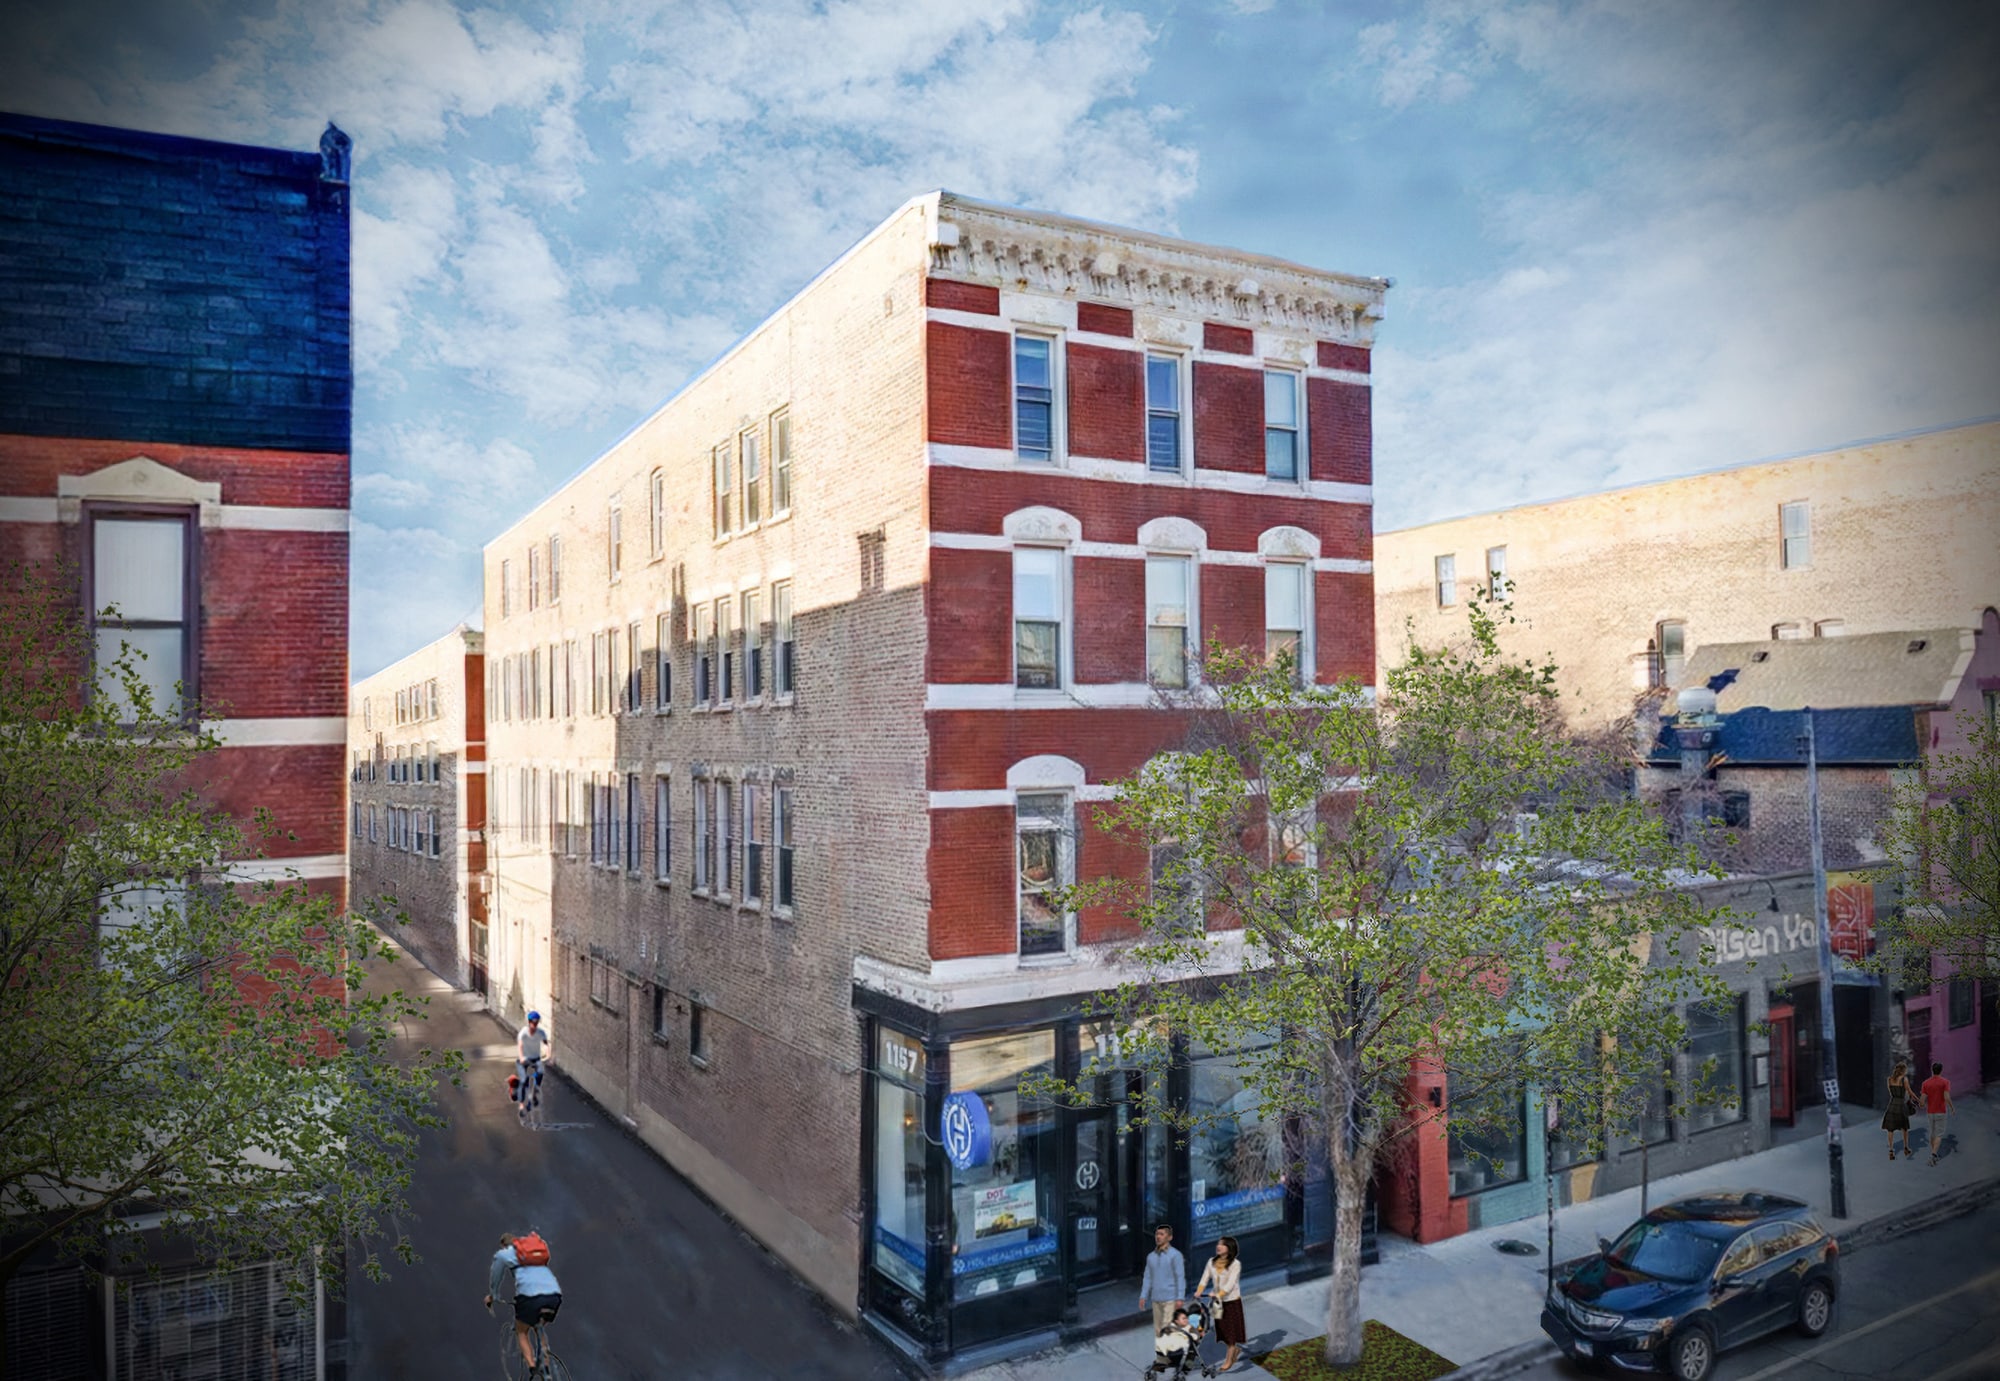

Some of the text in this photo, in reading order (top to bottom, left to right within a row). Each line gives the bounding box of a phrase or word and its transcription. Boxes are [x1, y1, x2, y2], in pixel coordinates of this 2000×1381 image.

[885, 1040, 918, 1073] 1157
[987, 1248, 1023, 1263] HEALTH
[1024, 1240, 1056, 1255] STUDIO
